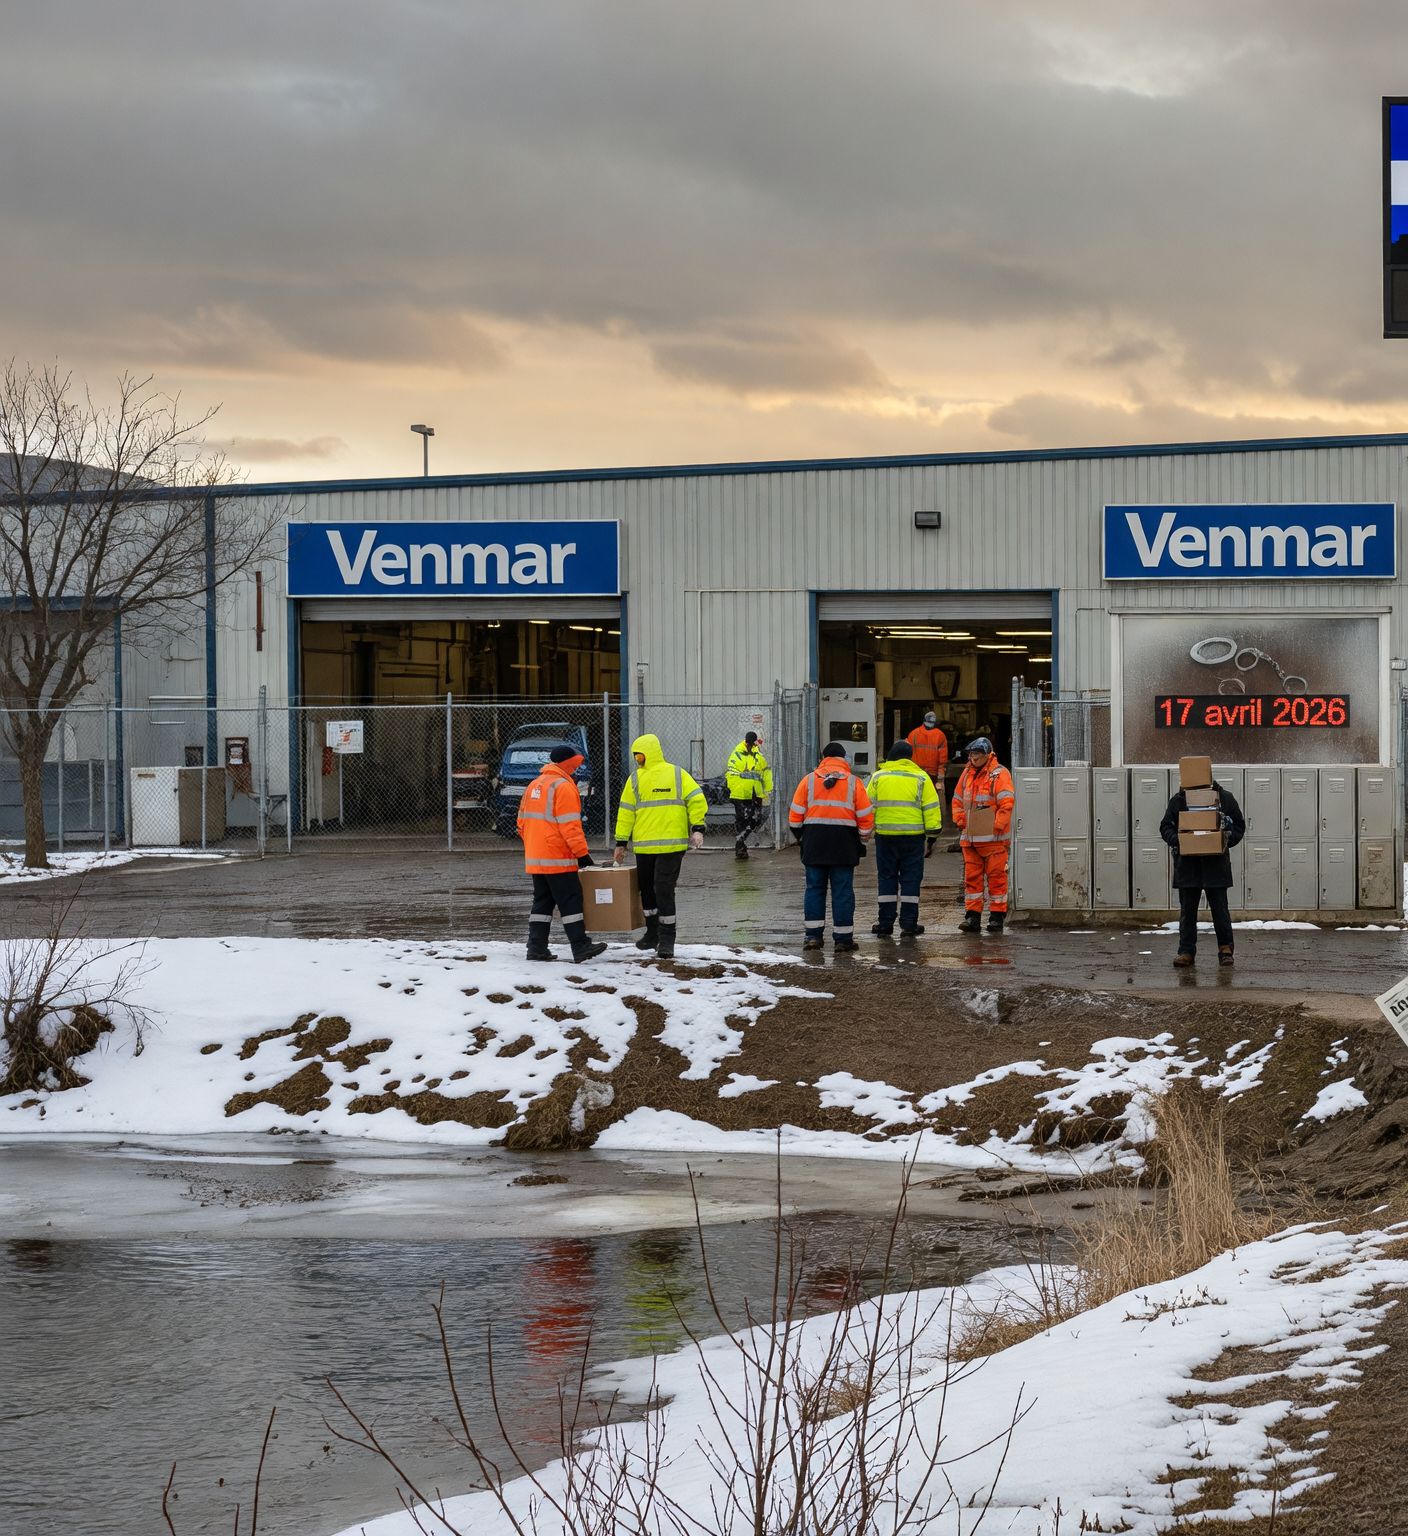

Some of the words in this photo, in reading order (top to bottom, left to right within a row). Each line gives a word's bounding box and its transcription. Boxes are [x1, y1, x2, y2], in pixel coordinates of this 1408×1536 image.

[325, 529, 577, 586] Venmar
[1124, 512, 1377, 568] Venmar
[1160, 697, 1194, 726] 17
[1205, 697, 1262, 726] avril
[1272, 697, 1347, 727] 2026
